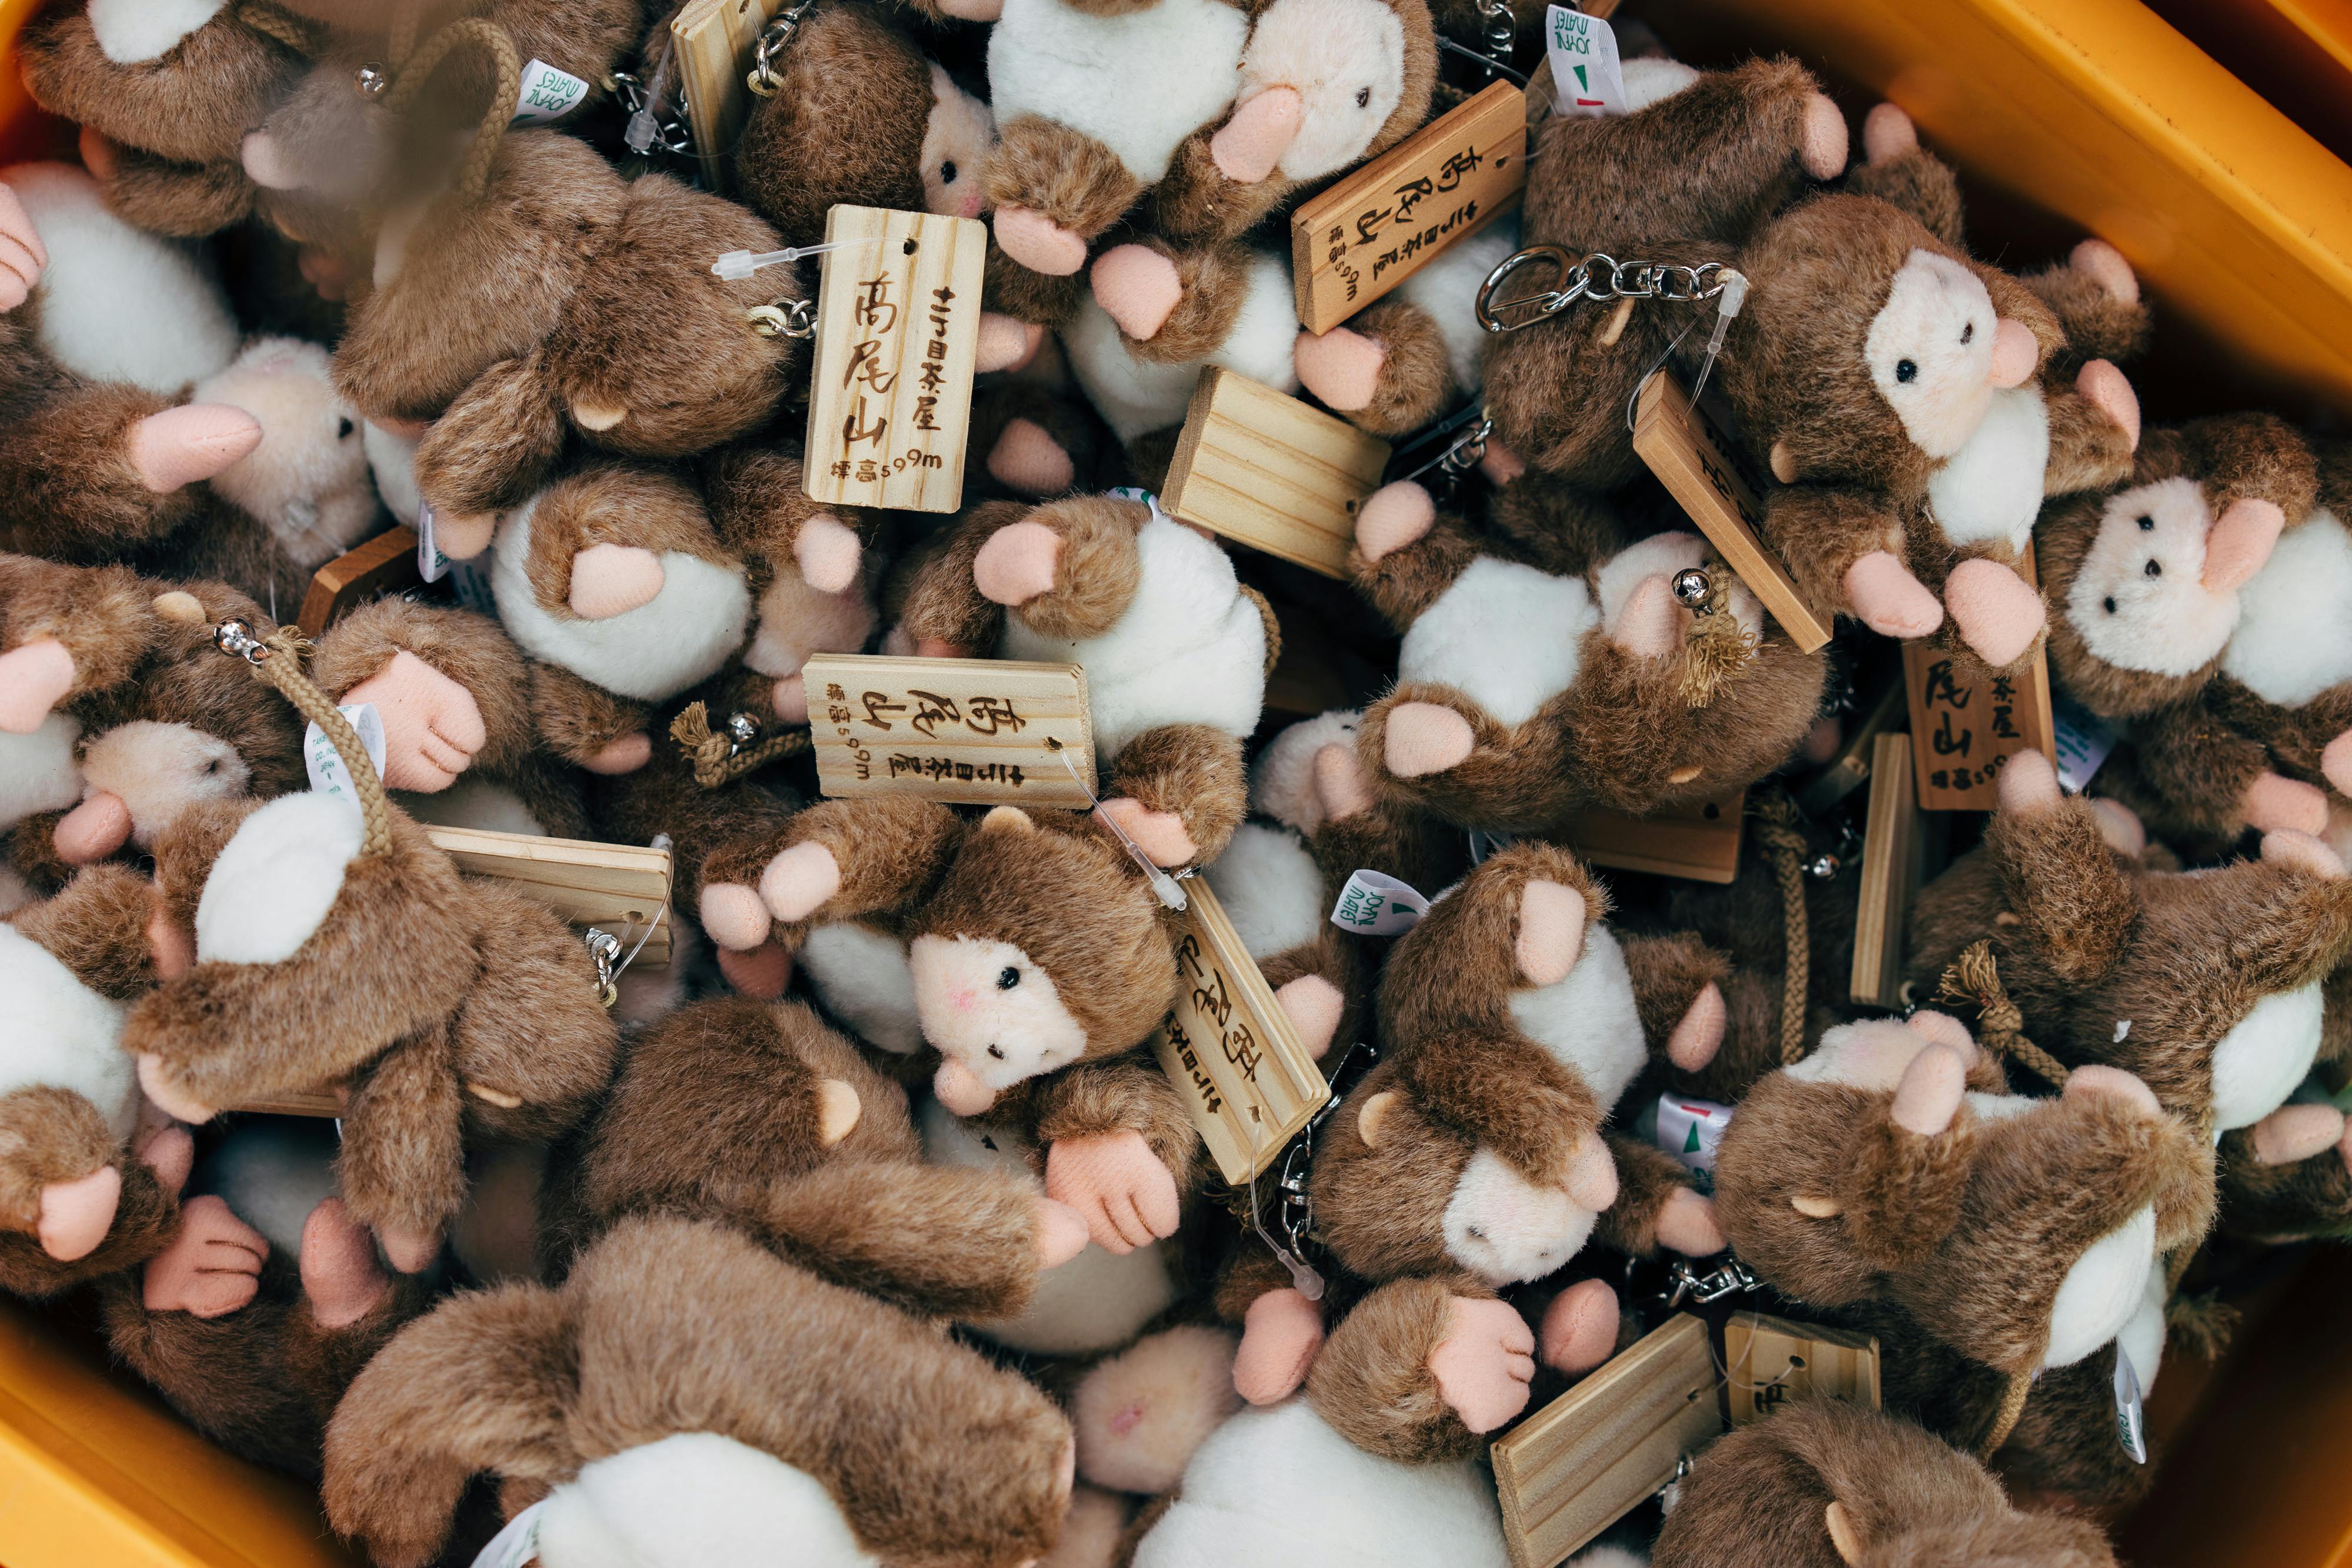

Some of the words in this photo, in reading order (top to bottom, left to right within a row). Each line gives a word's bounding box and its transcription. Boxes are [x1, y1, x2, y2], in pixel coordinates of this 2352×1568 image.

[1555, 11, 1589, 35] MATES
[536, 71, 580, 98] MATES
[1354, 145, 1483, 246] 高尾山
[843, 271, 898, 448] 高尾山
[861, 689, 1027, 740] 高尾山
[1925, 660, 1973, 758] 尾山
[1339, 885, 1365, 925] MATES
